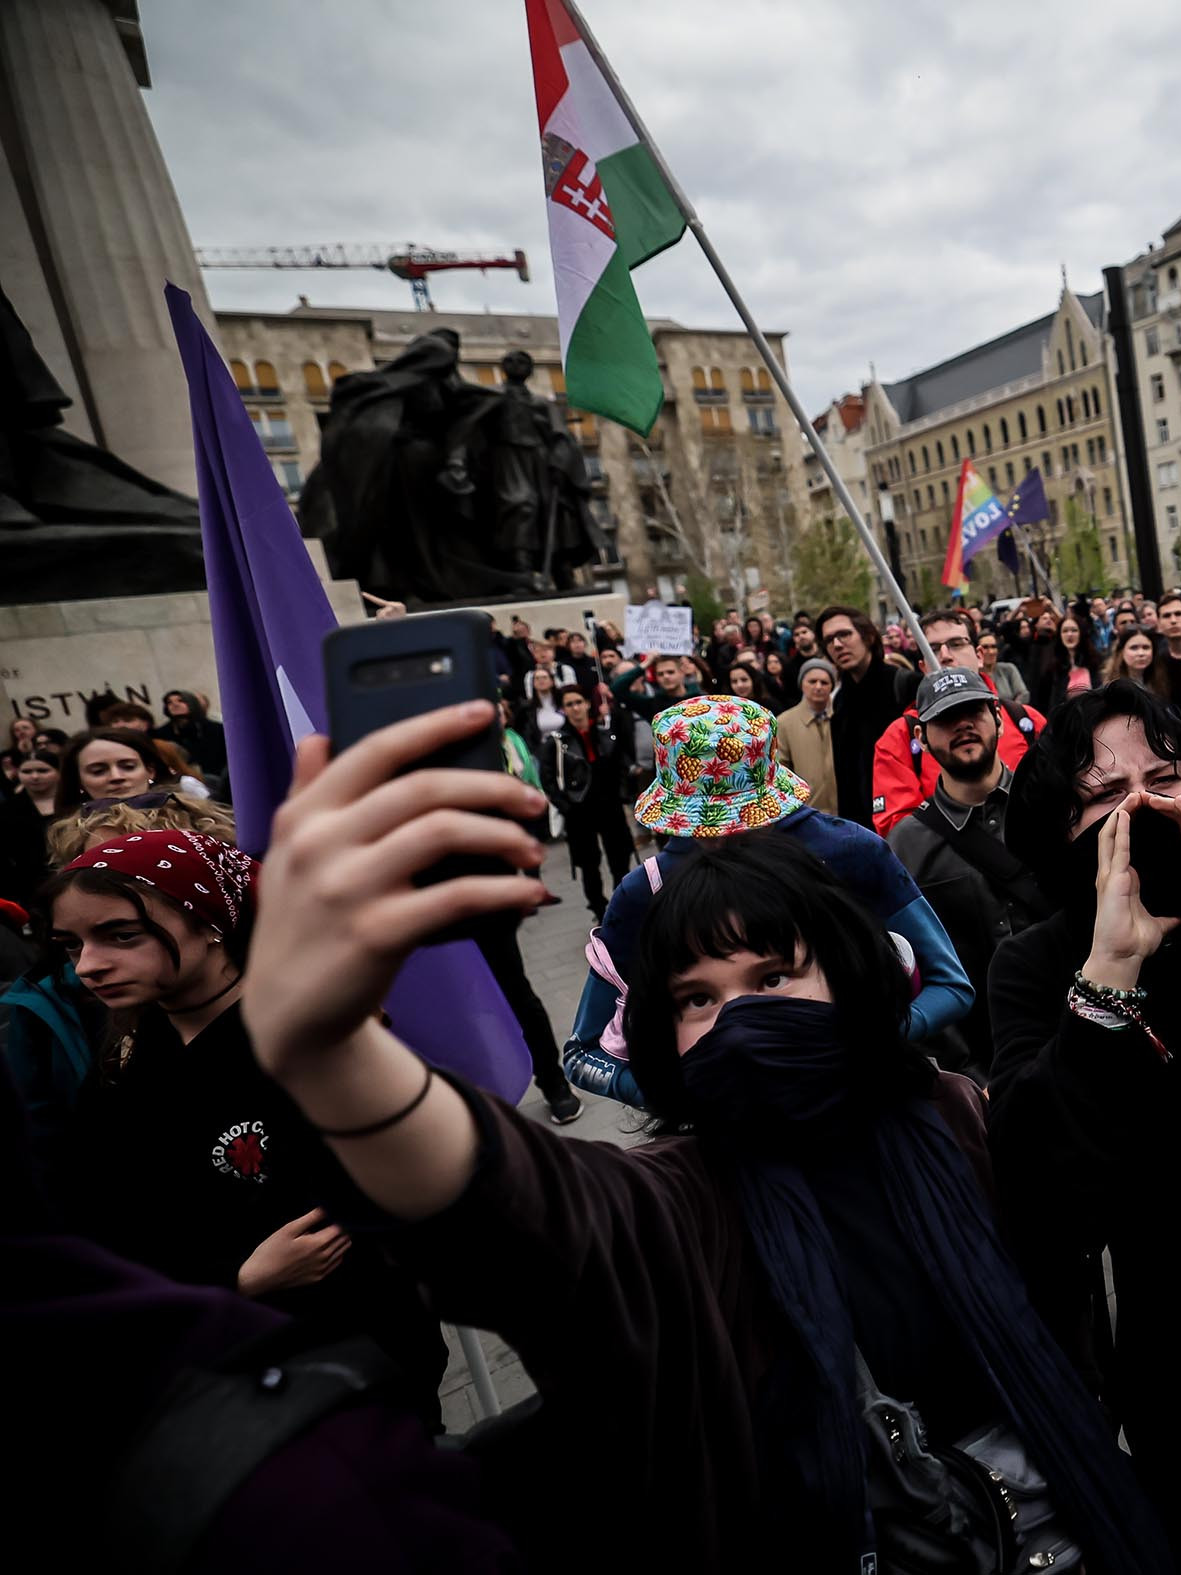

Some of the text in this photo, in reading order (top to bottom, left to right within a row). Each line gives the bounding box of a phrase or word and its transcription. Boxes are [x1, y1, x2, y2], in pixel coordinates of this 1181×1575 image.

[12, 681, 152, 720] ISTVN
[212, 1121, 250, 1173] RED HOT
